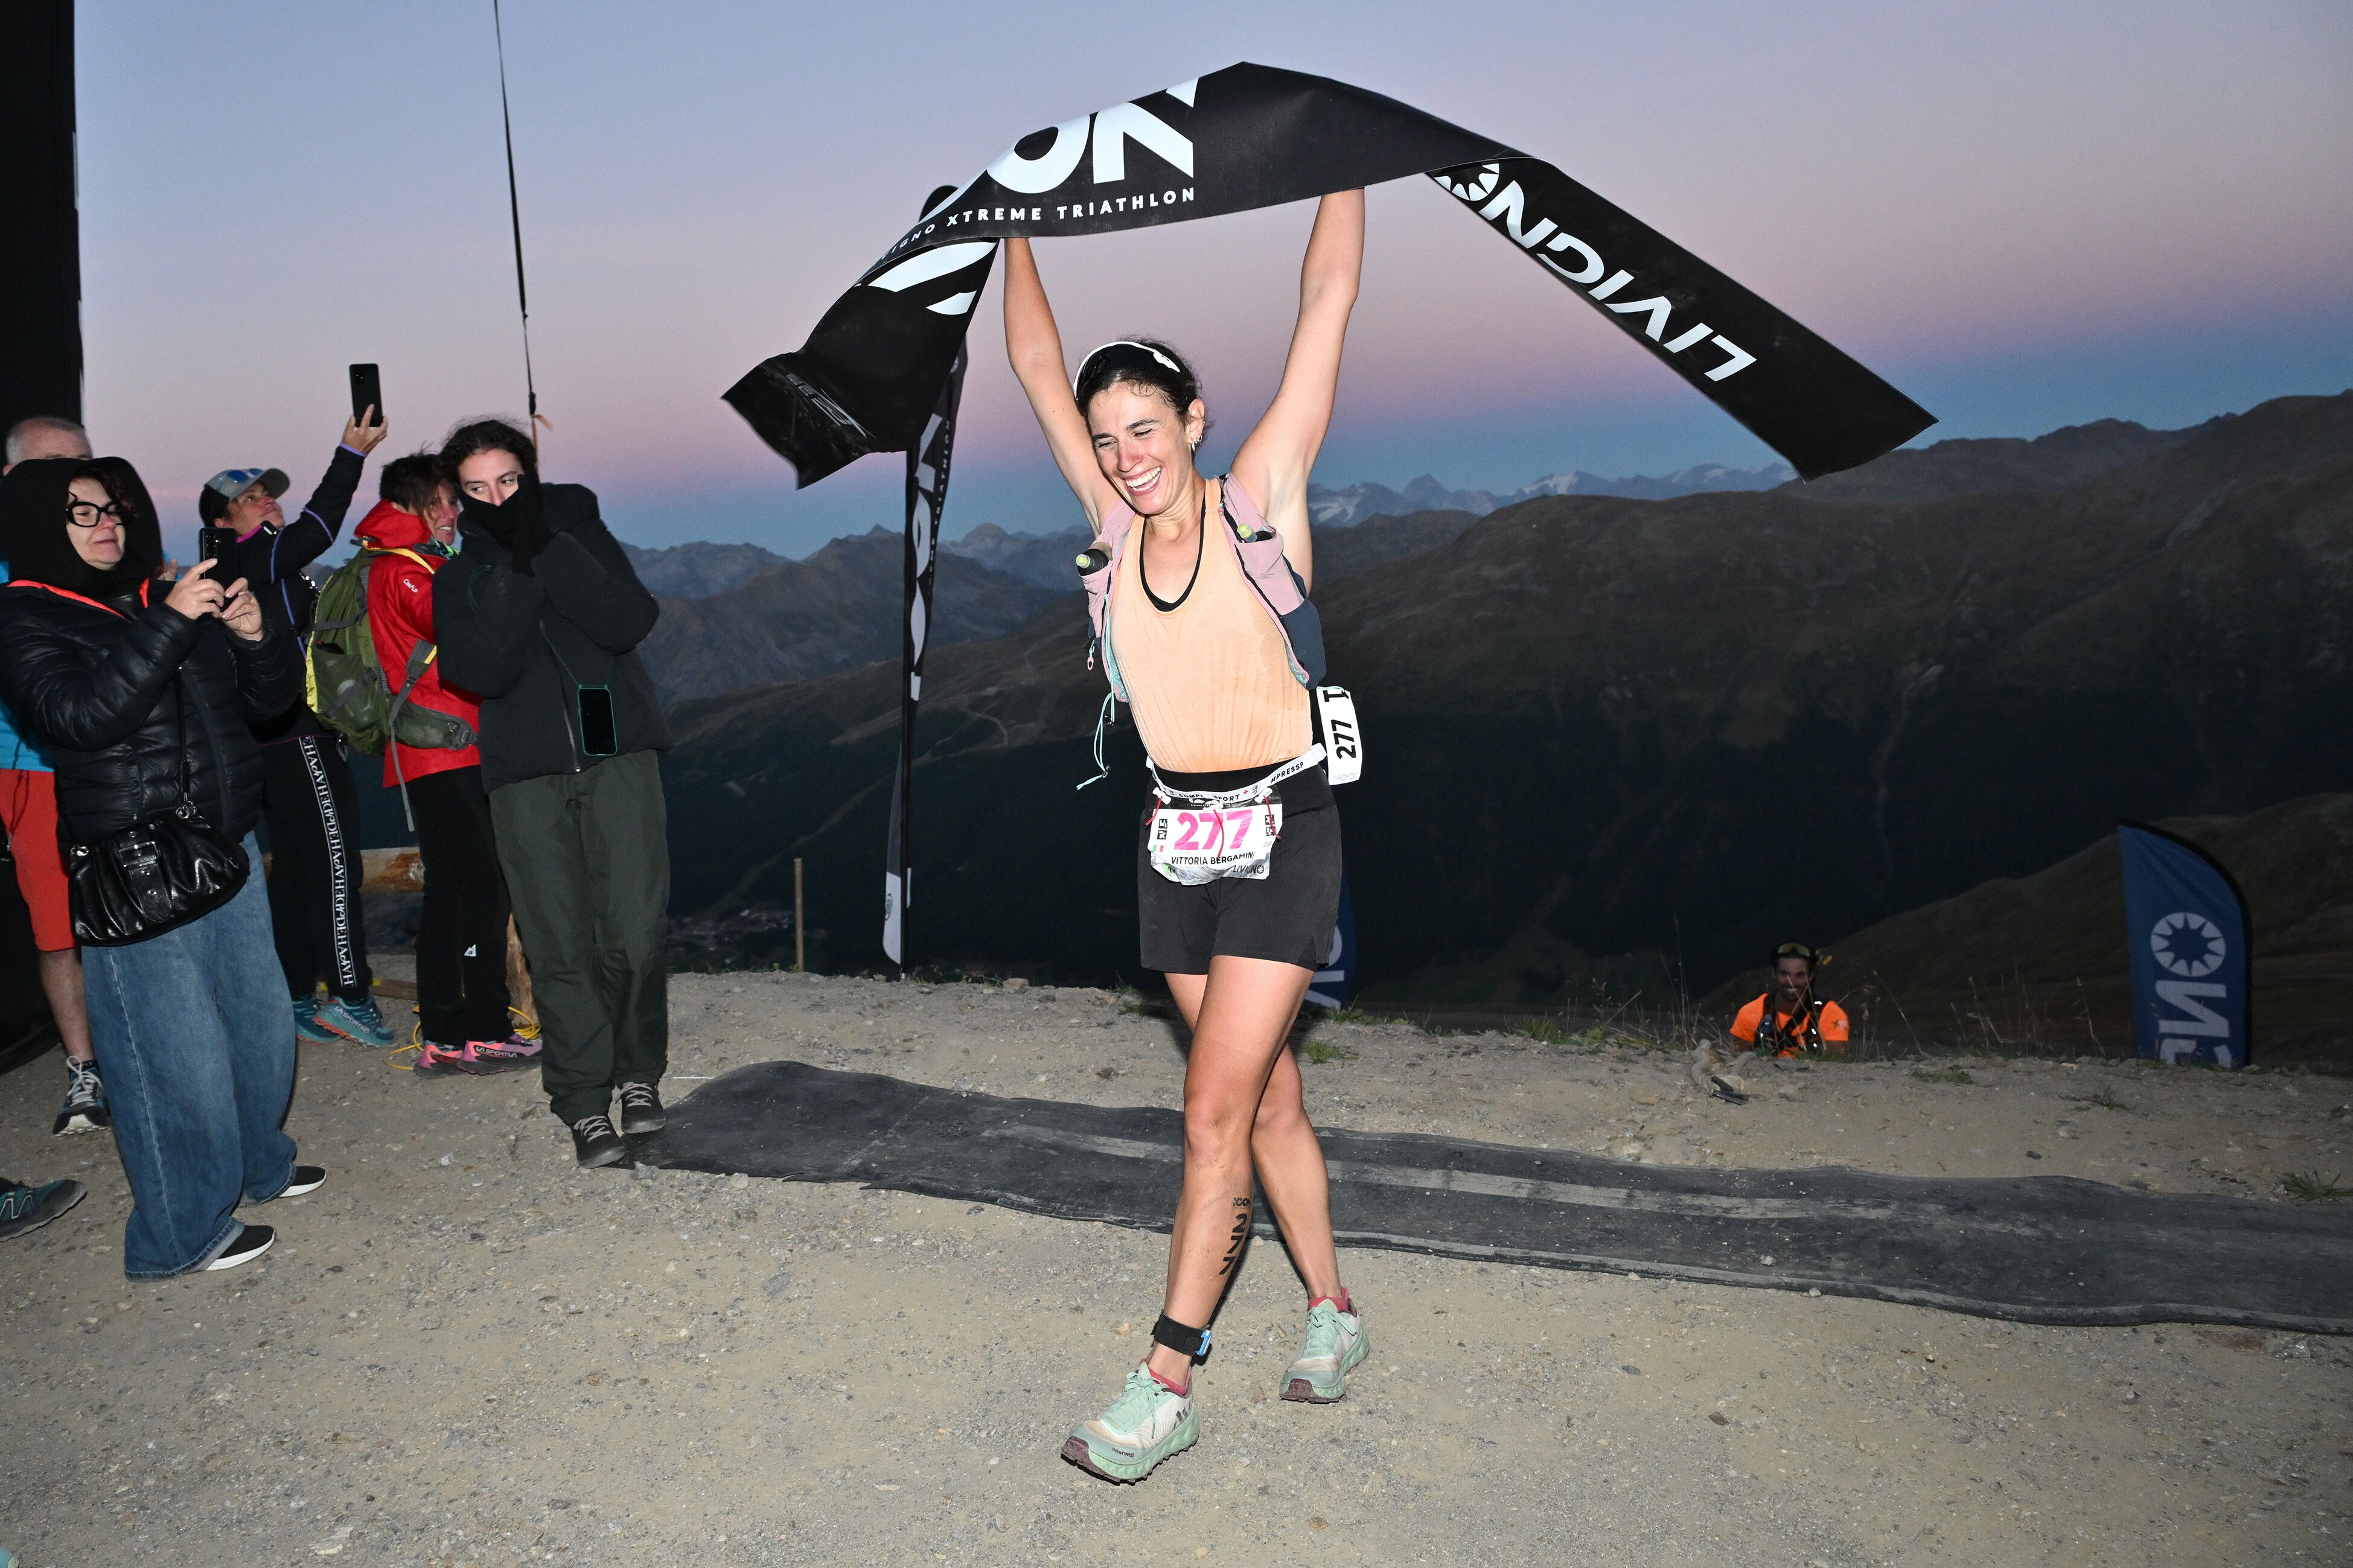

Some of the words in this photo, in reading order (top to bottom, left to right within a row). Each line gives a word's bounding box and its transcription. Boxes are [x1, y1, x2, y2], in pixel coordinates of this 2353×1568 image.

[947, 208, 1041, 226] XTREME
[1058, 187, 1194, 220] TRIATHLON
[1330, 719, 1356, 759] 277
[1174, 809, 1253, 850] 277
[1171, 856, 1208, 865] VITTORIA
[1219, 1213, 1248, 1275] 277
